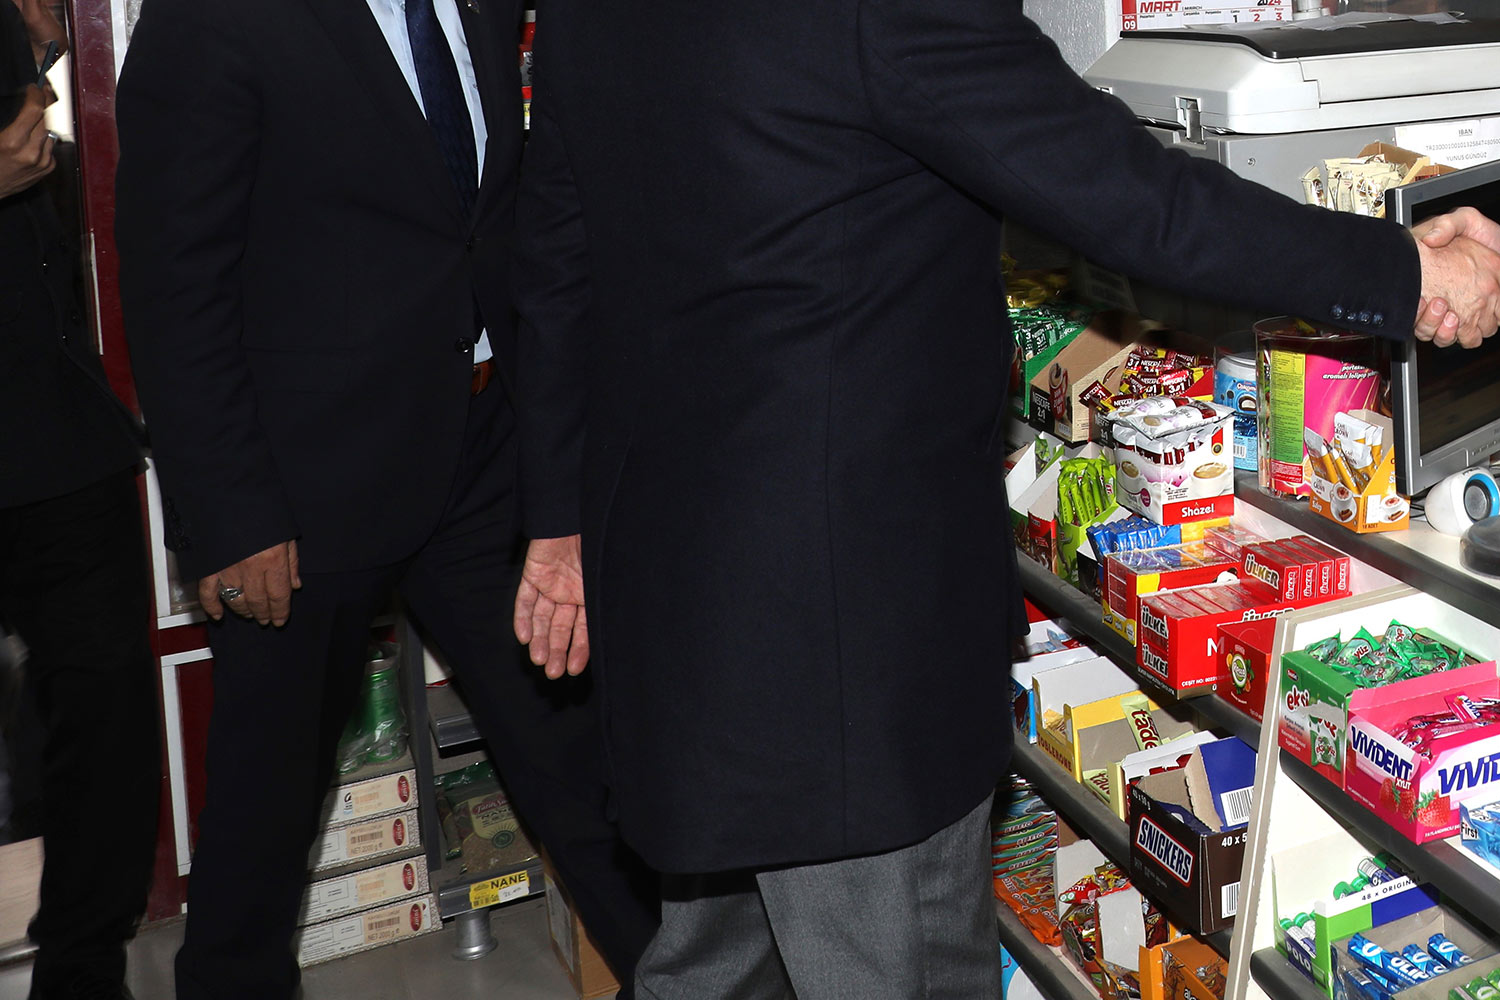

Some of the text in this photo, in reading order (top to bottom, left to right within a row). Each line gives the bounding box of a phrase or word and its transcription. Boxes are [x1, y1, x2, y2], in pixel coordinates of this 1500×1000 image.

[1140, 0, 1181, 13] MART
[1181, 502, 1215, 518] Shazel
[1245, 554, 1279, 589] ÜLKER
[1337, 563, 1347, 591] ÜLKER
[1285, 571, 1295, 600] ÜLKER
[1460, 821, 1478, 840] First
[1138, 818, 1191, 883] SNICKERS
[1222, 836, 1232, 847] 40
[490, 873, 527, 889] NANE
